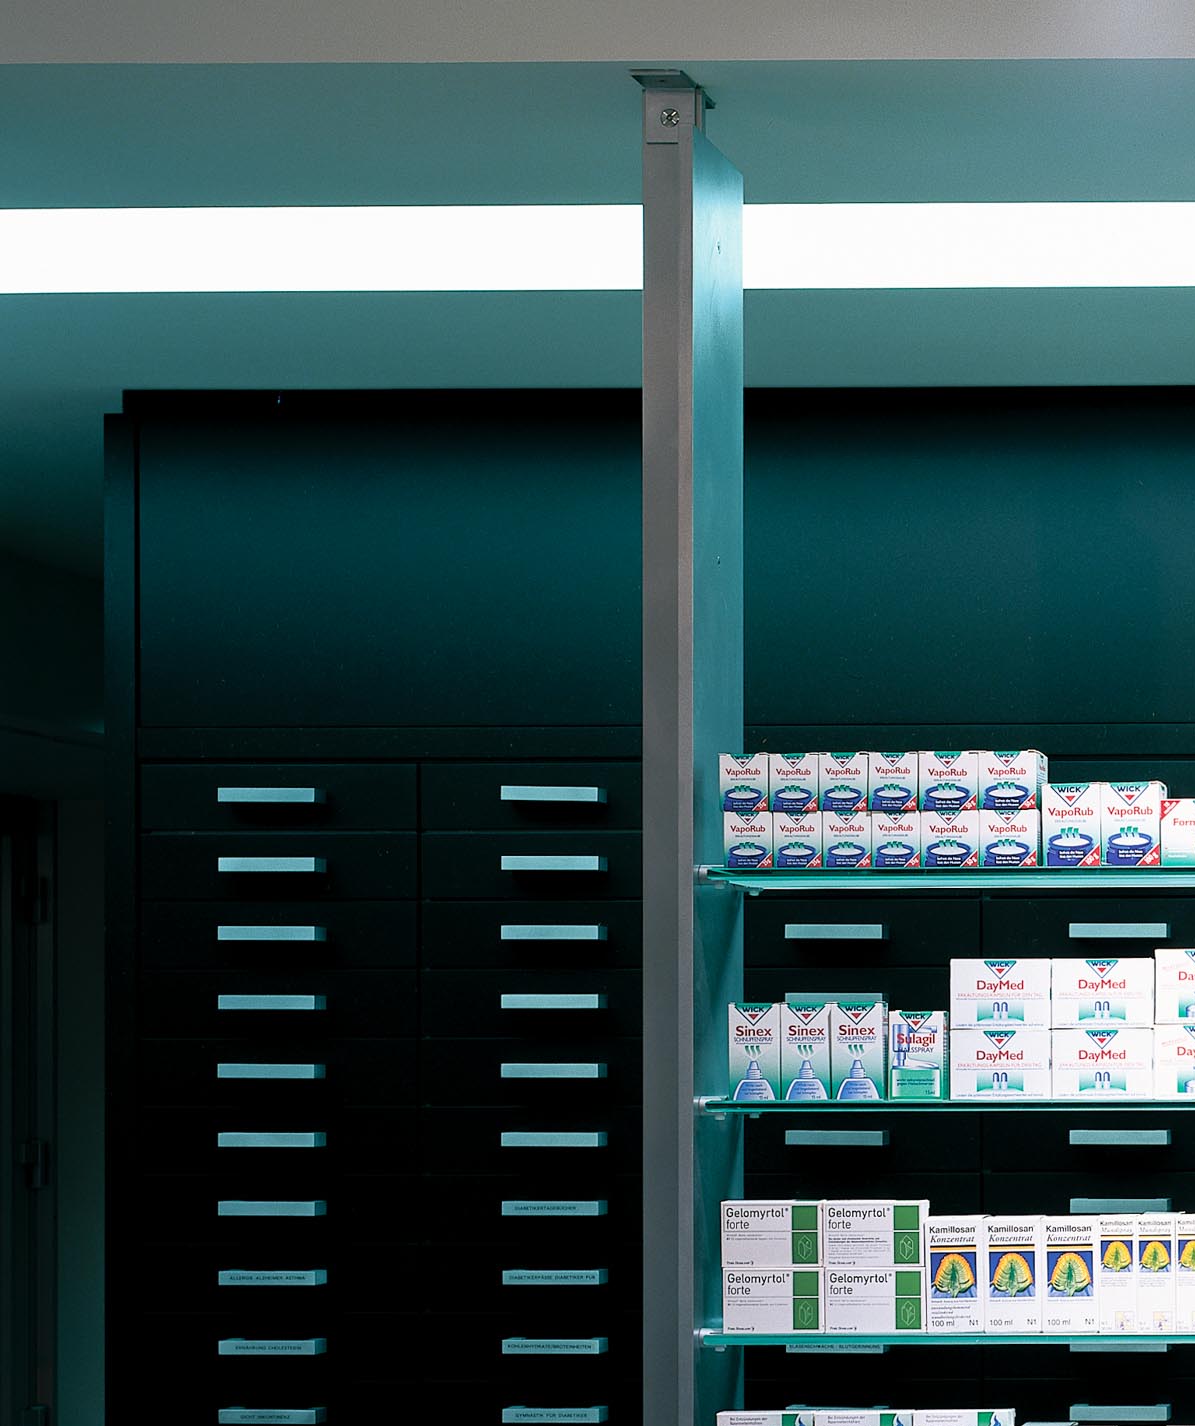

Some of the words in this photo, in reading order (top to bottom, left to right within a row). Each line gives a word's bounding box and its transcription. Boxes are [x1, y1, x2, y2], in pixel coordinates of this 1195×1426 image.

[825, 768, 861, 776] VapoRub
[875, 767, 910, 775] VapoRub
[928, 769, 967, 777] VapoRub
[988, 768, 1026, 776] VapoRub
[1048, 808, 1094, 818] VapoRub
[1107, 807, 1153, 816] VapoRub
[929, 826, 968, 834] VapoRub
[988, 825, 1027, 833] VapoRub
[976, 981, 1024, 992] DayMed
[1078, 980, 1126, 991] DayMed
[736, 1026, 772, 1036] Sinex
[788, 1025, 825, 1036] Sinex
[838, 1025, 875, 1036] Sinex
[897, 1033, 935, 1047] Sulagil
[976, 1050, 1023, 1062] DayMed
[1078, 1050, 1126, 1062] DayMed
[726, 1220, 749, 1229] forte
[828, 1220, 851, 1229] forte
[1046, 1234, 1091, 1242] Konzentrat
[830, 1286, 853, 1295] forte
